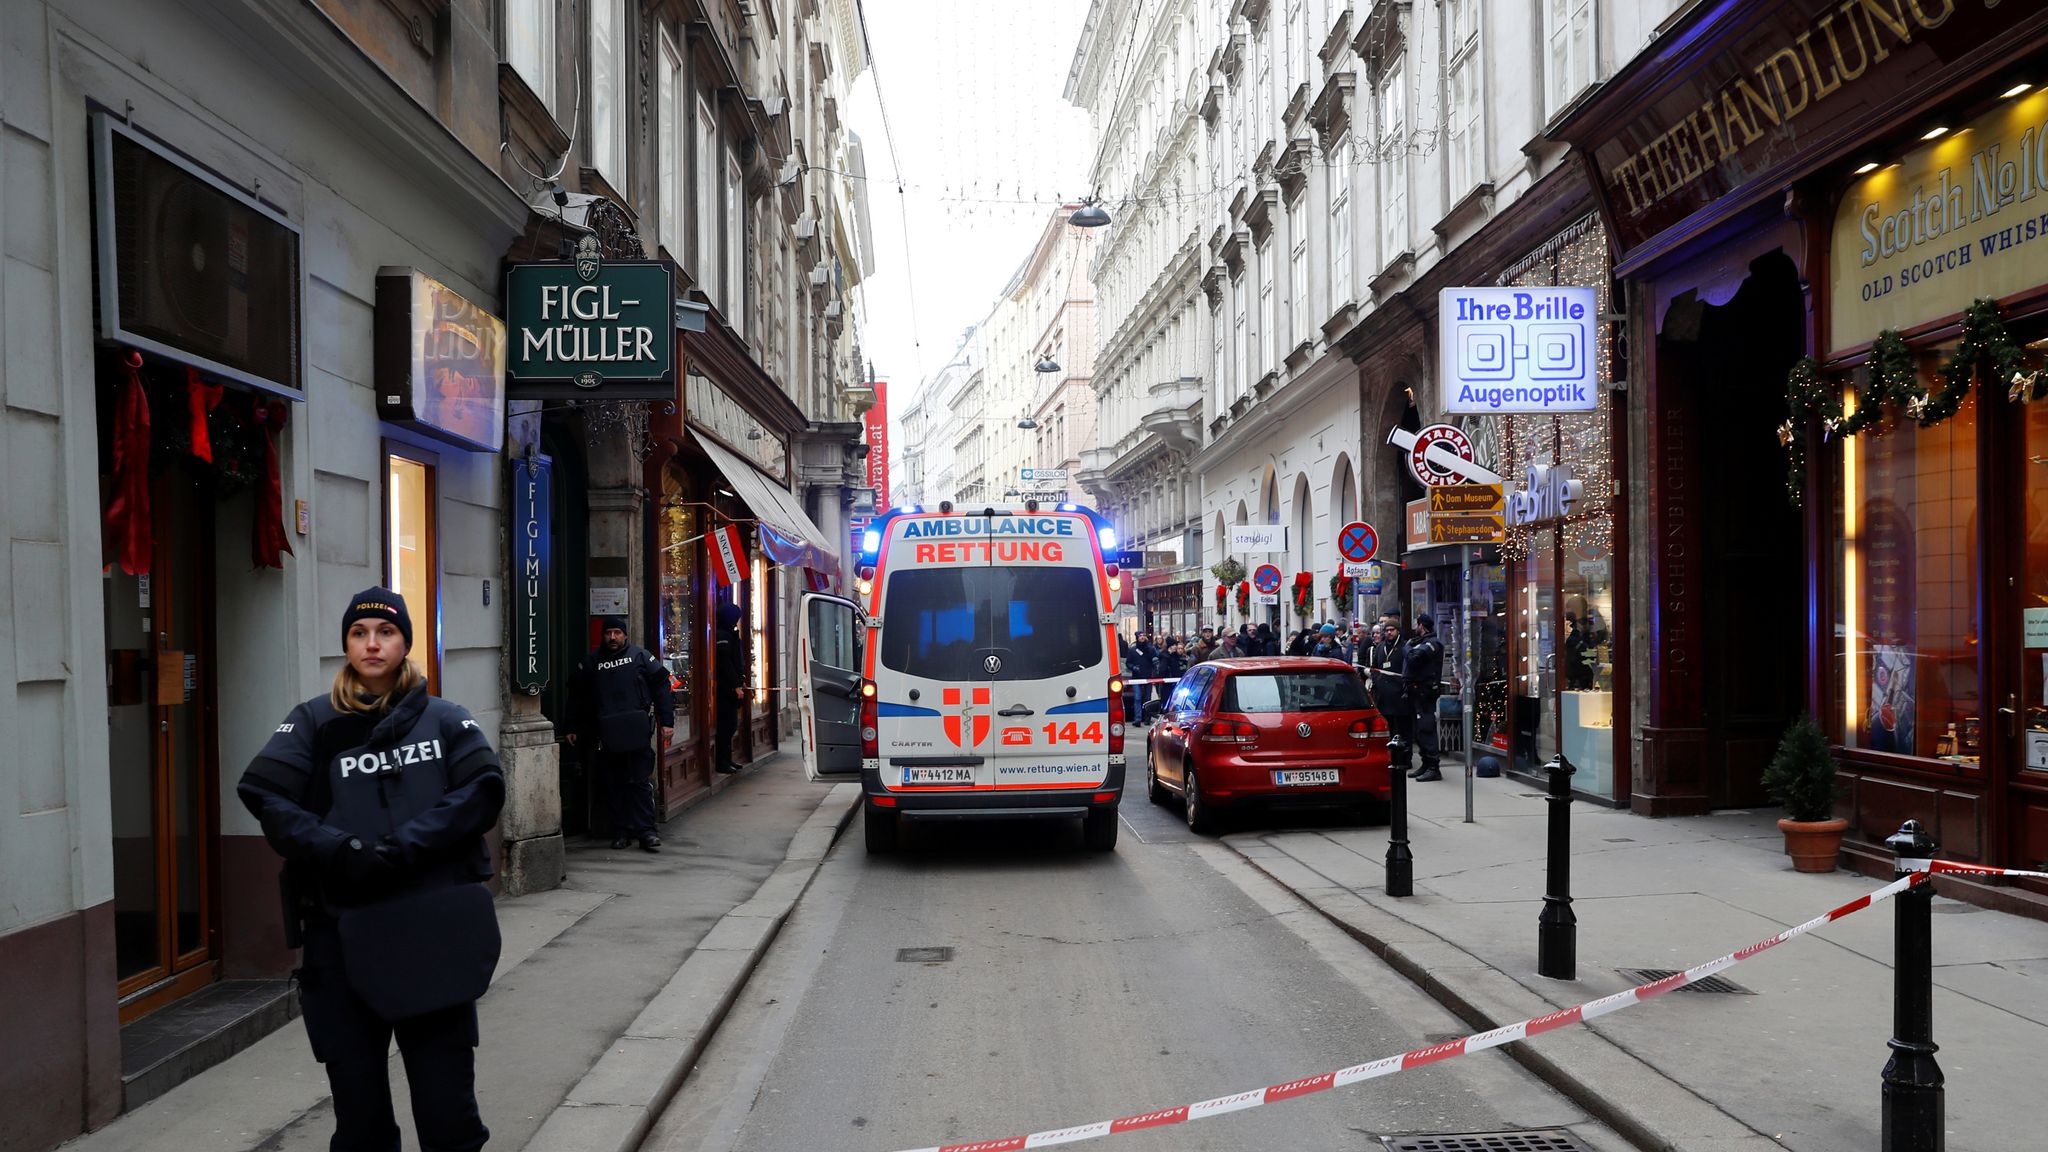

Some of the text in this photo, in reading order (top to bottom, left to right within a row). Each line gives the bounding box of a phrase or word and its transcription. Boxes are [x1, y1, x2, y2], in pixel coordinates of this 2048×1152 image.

[1860, 167, 1967, 268] Scotch
[1862, 275, 1893, 301] OLD
[1901, 243, 1973, 288] SCOTCH
[541, 285, 640, 320] FIGL-
[521, 325, 657, 362] MÜLLER
[1458, 384, 1585, 408] Augenoptik
[1424, 429, 1470, 455] TABAK
[1415, 451, 1456, 486] TRAFIK
[1446, 493, 1494, 503] Dom Museum
[904, 518, 1073, 538] AMBULANCE
[1413, 511, 1428, 535] TABA
[1446, 525, 1495, 535] Stephansdom
[1235, 533, 1273, 545] staudigl
[718, 534, 737, 575] SINCE 1837
[916, 542, 1063, 563] RETTUNG
[526, 482, 540, 674] FIGLMÜLLER
[1260, 596, 1275, 604] Ende
[598, 657, 632, 670] POLIZEI
[276, 723, 295, 733] ZEI
[461, 719, 480, 729] PO
[1042, 721, 1104, 744] 144
[340, 739, 442, 778] POLIZEI
[999, 763, 1101, 775] www.rettung.wien.at
[911, 767, 971, 780] W 4412 MA
[1284, 771, 1335, 782] W 95148 G
